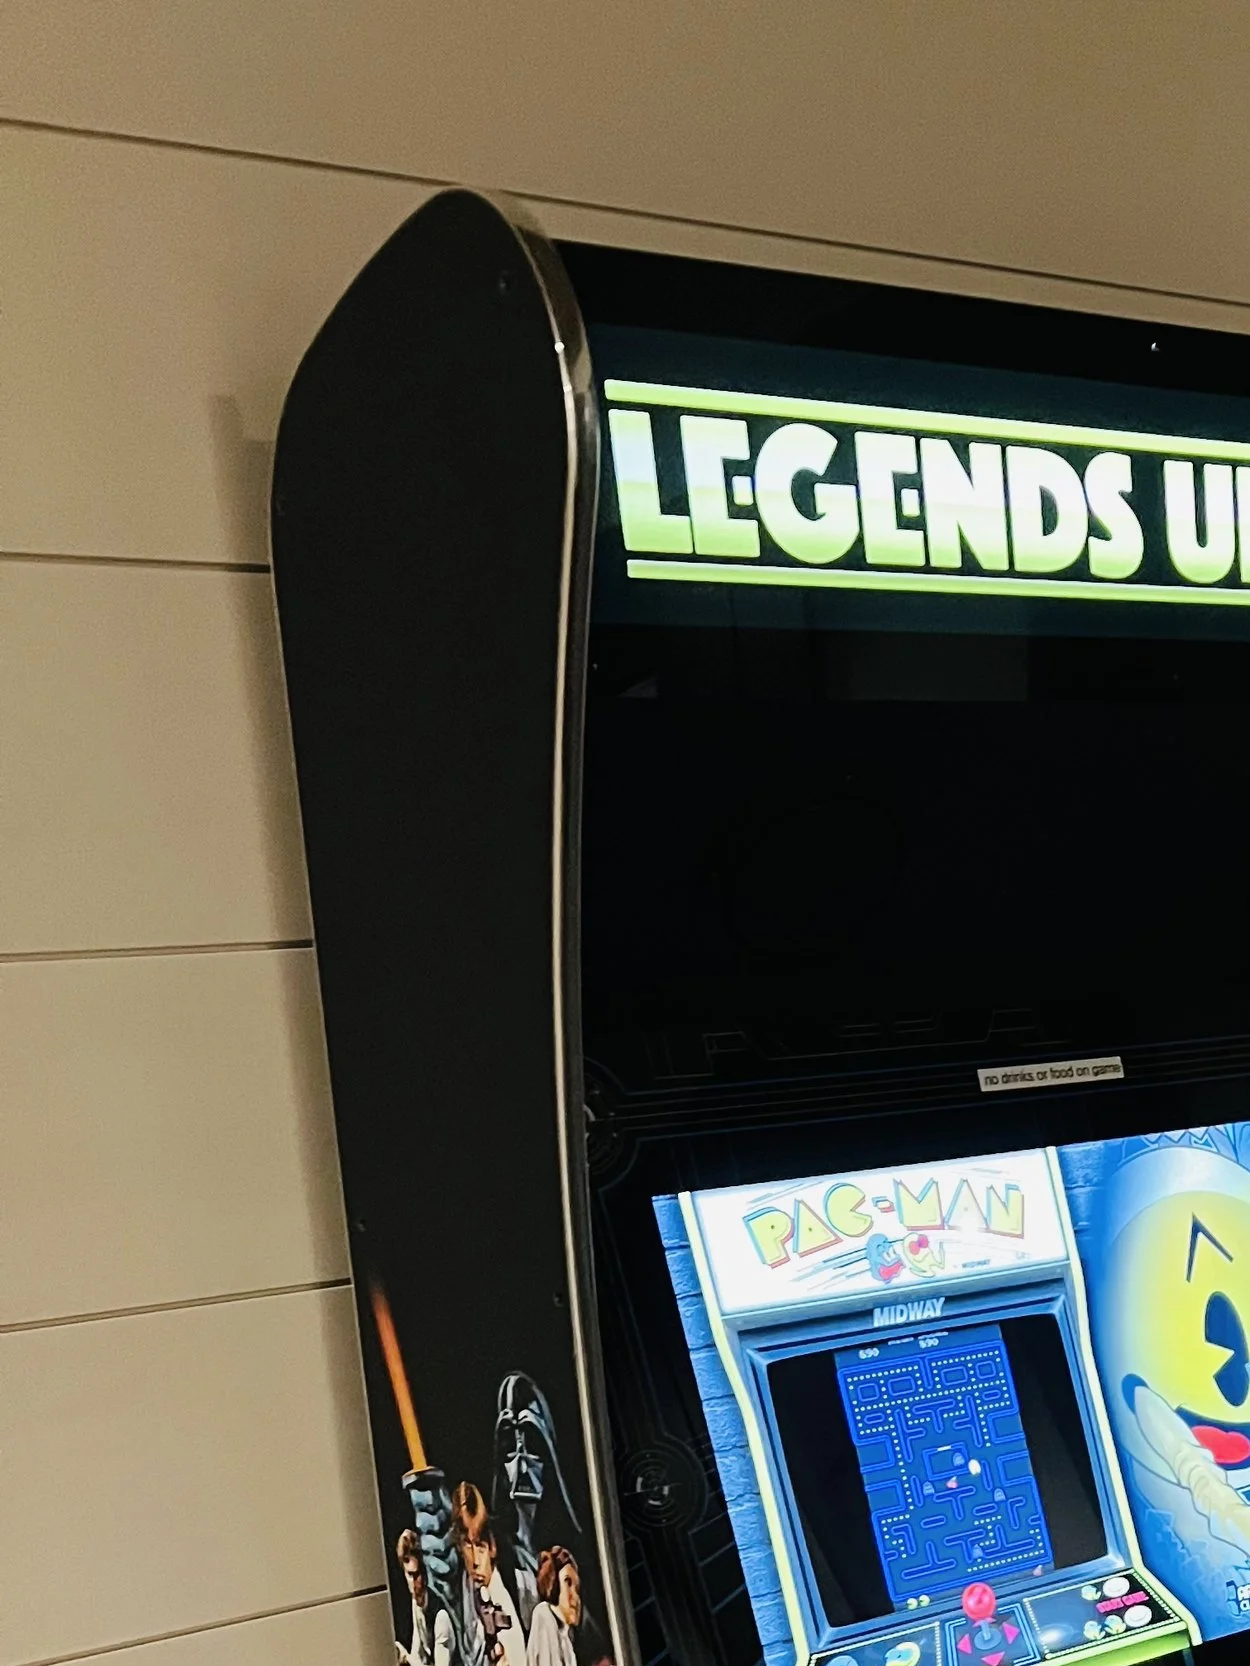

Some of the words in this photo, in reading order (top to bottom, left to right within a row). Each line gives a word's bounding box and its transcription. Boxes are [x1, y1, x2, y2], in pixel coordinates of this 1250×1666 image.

[609, 410, 1143, 579] LEGENDS
[984, 1075, 999, 1086] no
[1002, 1070, 1035, 1083] drinks
[1036, 1070, 1048, 1080] or
[1050, 1066, 1074, 1079] food
[1076, 1066, 1090, 1076] on
[1092, 1063, 1121, 1076] game
[743, 1177, 1025, 1268] PAC-MAN
[873, 1297, 945, 1327] MIDWAY
